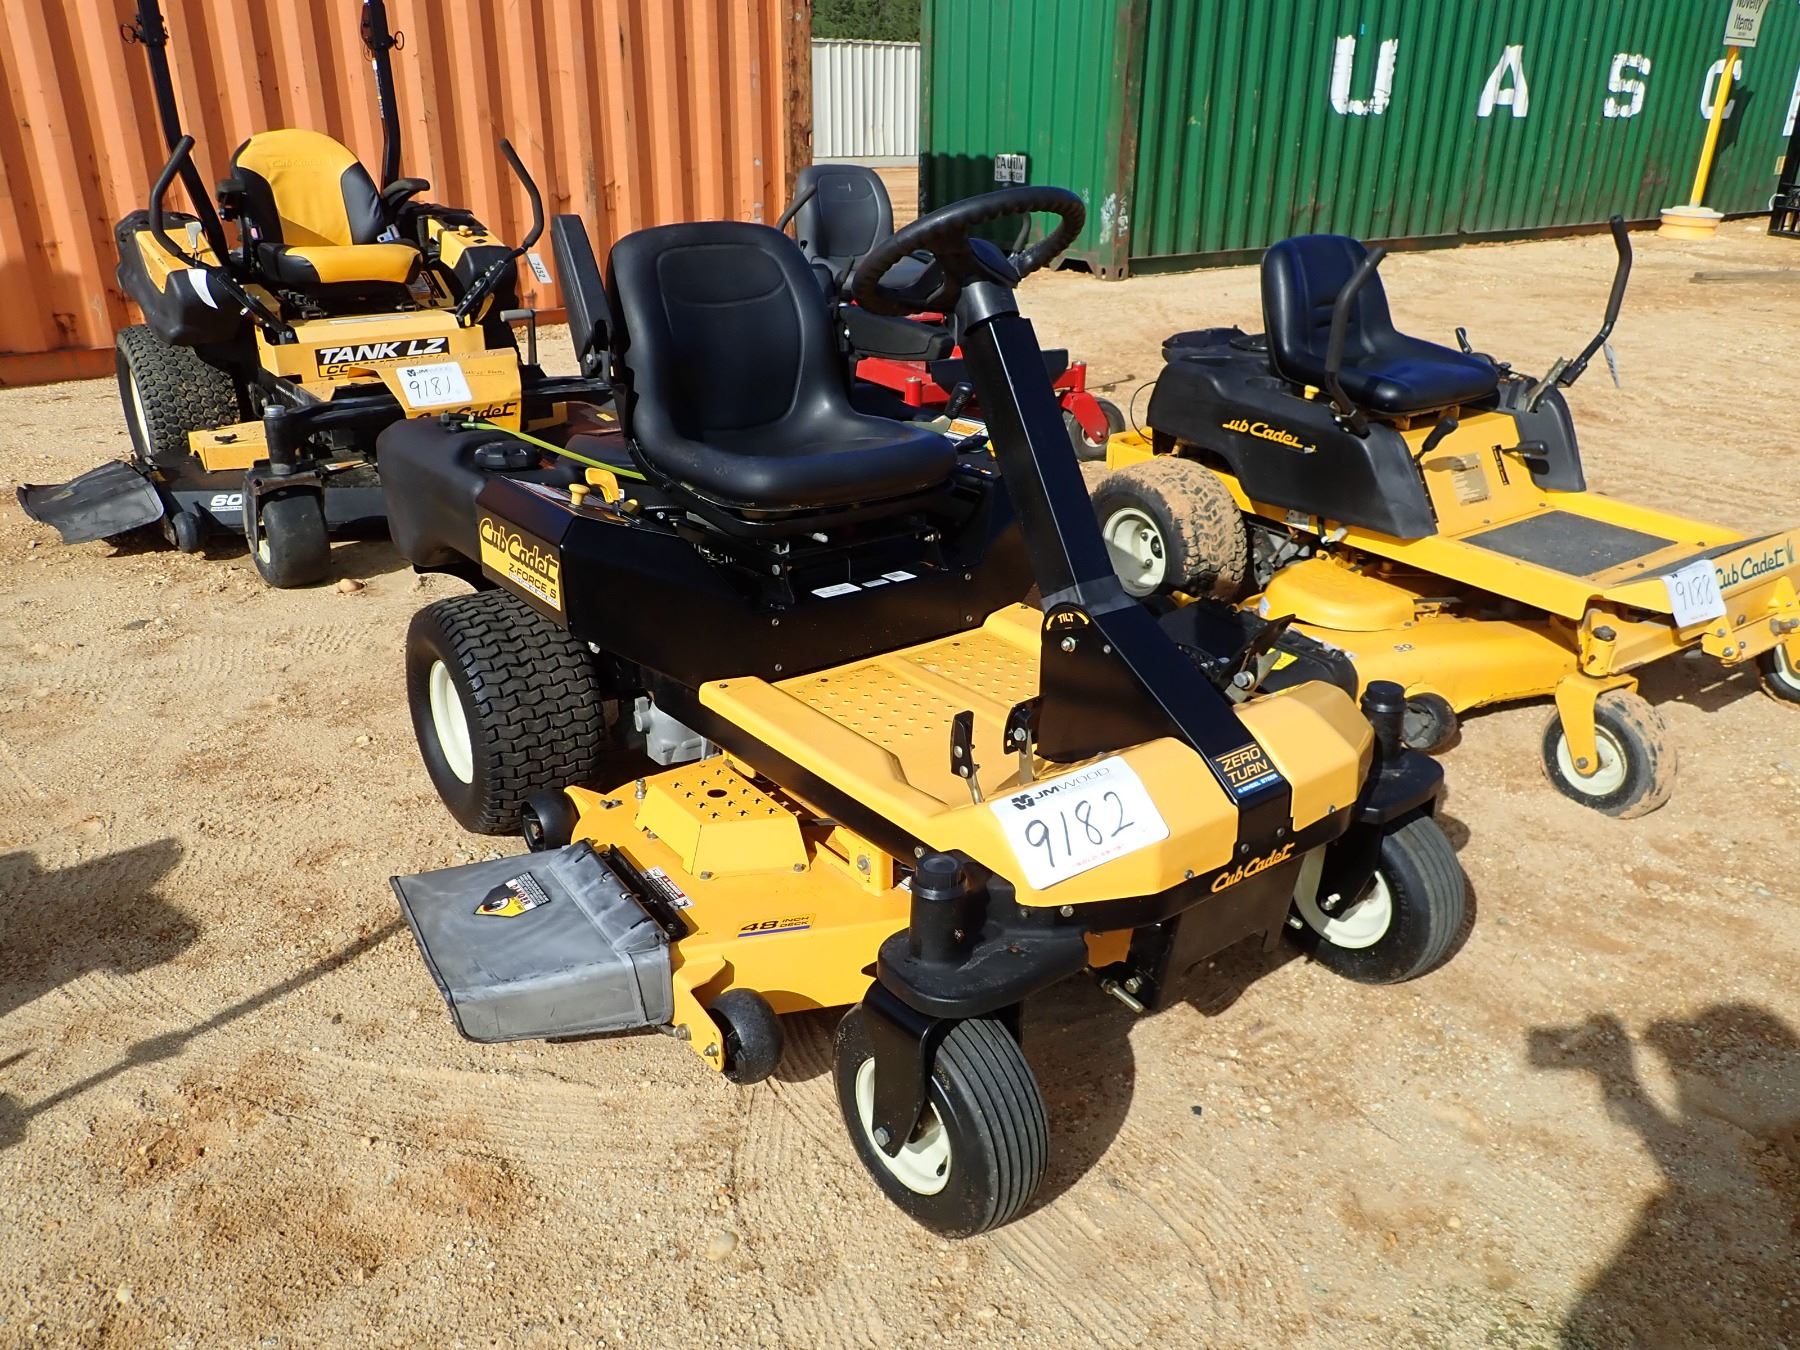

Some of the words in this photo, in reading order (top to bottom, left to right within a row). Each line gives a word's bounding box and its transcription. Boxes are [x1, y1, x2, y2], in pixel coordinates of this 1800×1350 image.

[1733, 14, 1754, 31] Items
[532, 261, 546, 278] 7452
[319, 341, 402, 365] TANK
[406, 337, 446, 357] LZ
[409, 375, 451, 399] 9181
[1222, 420, 1249, 433] ub
[210, 493, 243, 507] 60
[480, 517, 507, 554] Cub
[507, 533, 559, 585] Cadet
[1715, 563, 1740, 590] Cub
[1740, 548, 1786, 581] Cadet
[549, 588, 557, 600] S
[1057, 612, 1074, 624] TILT
[1221, 747, 1261, 773] ZERO
[1226, 759, 1269, 784] TURN
[1025, 791, 1135, 868] 9182
[1210, 864, 1244, 893] Cub
[1243, 841, 1296, 878] Cadet
[740, 920, 779, 932] 48
[782, 915, 810, 923] INCH
[779, 920, 809, 929] DECK
